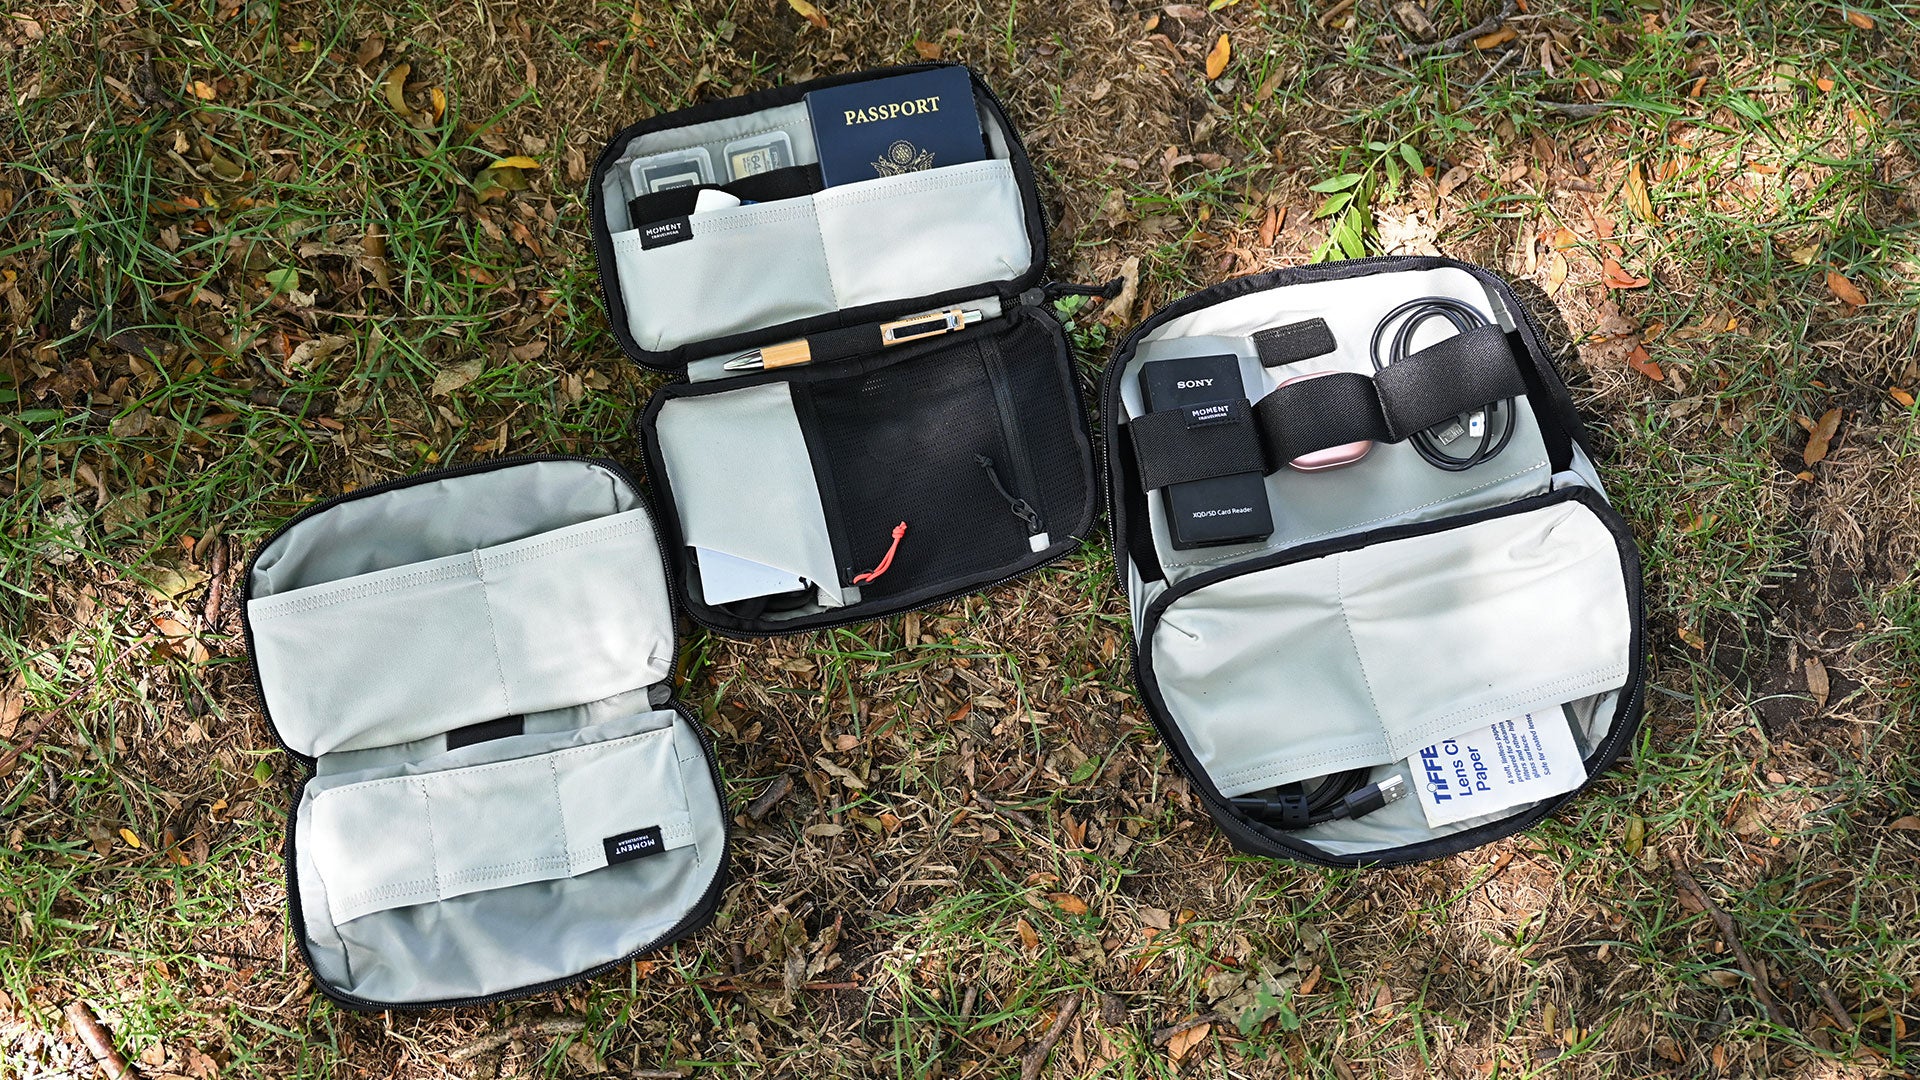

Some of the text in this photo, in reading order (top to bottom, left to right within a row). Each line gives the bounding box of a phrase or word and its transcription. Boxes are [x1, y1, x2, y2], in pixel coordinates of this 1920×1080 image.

[844, 96, 940, 125] PASSPORT
[646, 223, 681, 236] MOMENT
[1177, 379, 1213, 389] SONY
[1192, 406, 1229, 417] MOMENT
[1491, 724, 1501, 740] pape
[1511, 733, 1520, 748] other
[1530, 731, 1542, 750] coated
[1516, 750, 1524, 761] and
[1467, 746, 1491, 791] Paper
[1509, 755, 1524, 782] prepared
[1453, 759, 1473, 796] Lens
[616, 839, 655, 855] MOMENT
